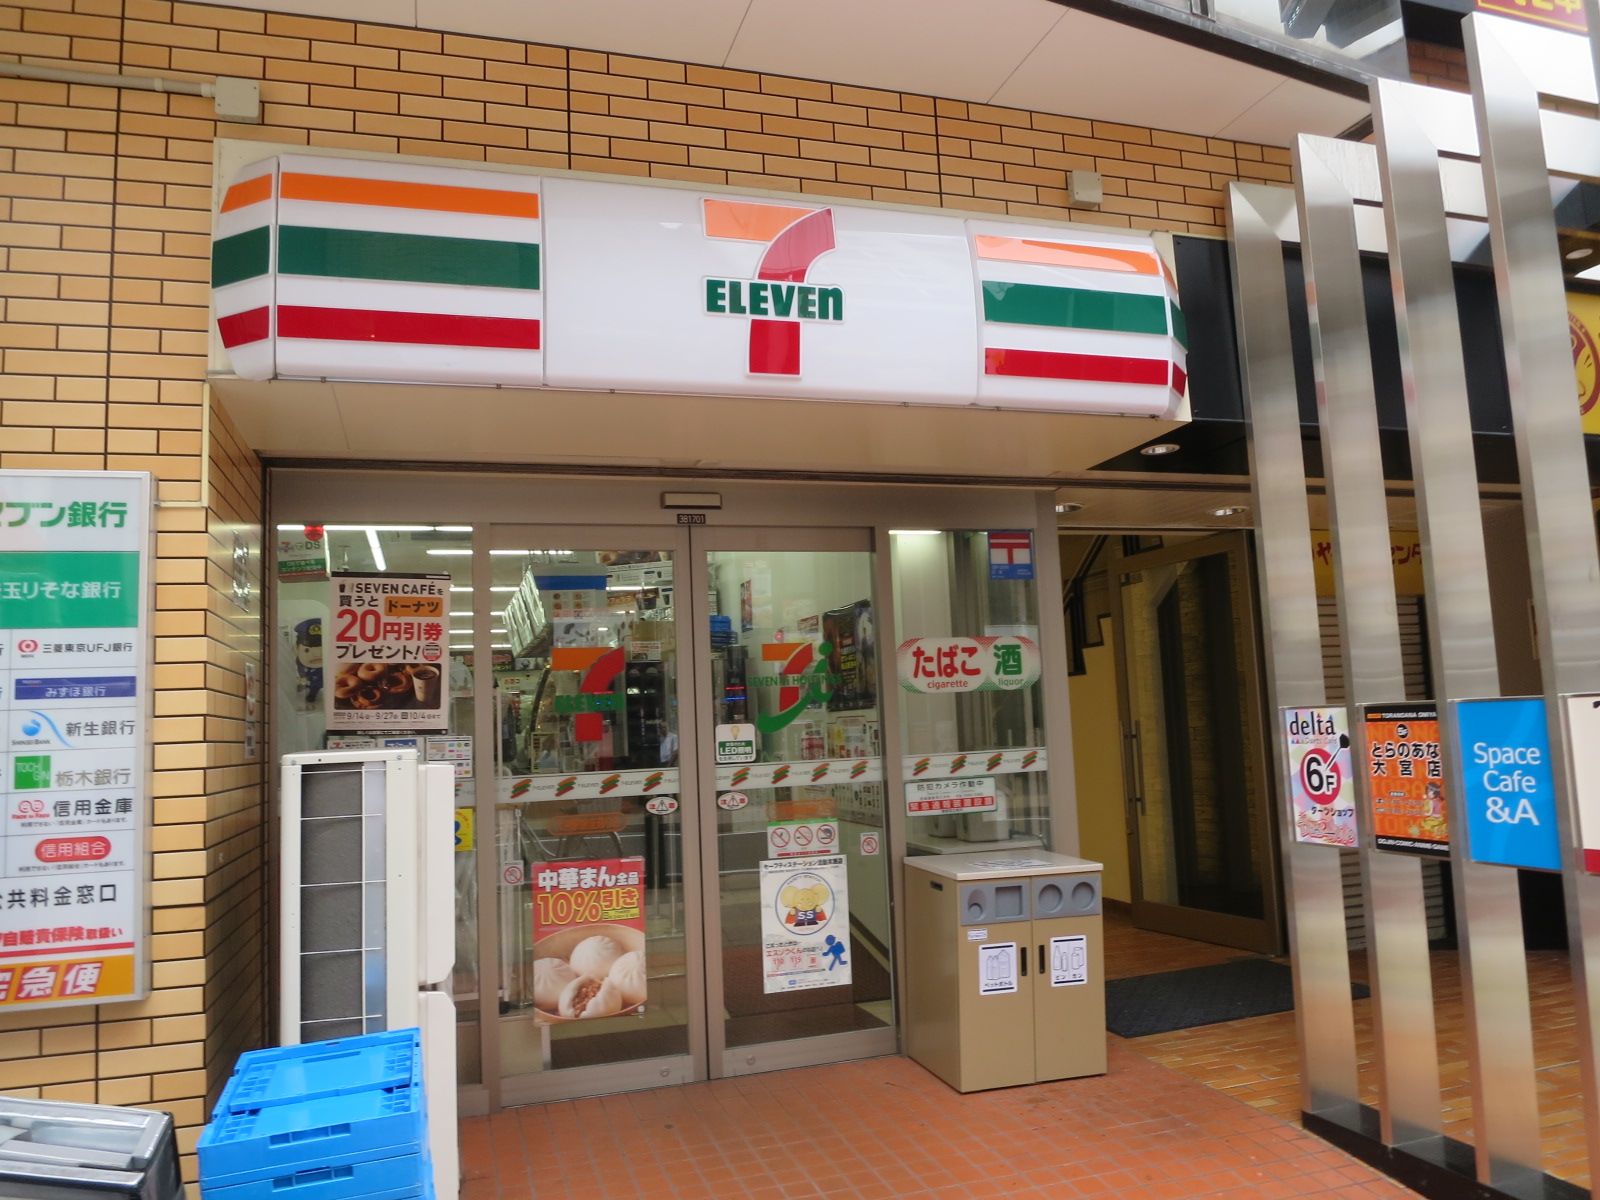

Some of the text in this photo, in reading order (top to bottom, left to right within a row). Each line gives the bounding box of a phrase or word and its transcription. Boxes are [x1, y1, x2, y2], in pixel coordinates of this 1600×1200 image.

[678, 514, 705, 524] 381701
[0, 581, 122, 600] 玉りそな銀行
[355, 582, 399, 594] SEVEN
[339, 595, 439, 613] 買うと ドーナツ
[336, 608, 443, 643] 20円引券
[42, 642, 133, 654] 三菱東京UFJ銀行
[912, 644, 981, 678] たばこ
[993, 644, 1022, 675] 酒
[45, 686, 107, 698] みずほ銀行
[927, 678, 969, 690] cigarette
[998, 678, 1025, 688] liquor
[66, 720, 136, 737] 新生銀行
[1290, 711, 1336, 735] delta
[1372, 742, 1439, 759] とらのあな
[1473, 743, 1540, 766] Space
[1484, 771, 1536, 793] Cafe
[53, 798, 134, 818] 信用金庫
[1486, 797, 1539, 826] &A
[41, 841, 107, 858] 信用組合
[538, 866, 639, 891] 中華まん全品
[537, 888, 639, 925] 10%引き
[798, 911, 814, 919] SS
